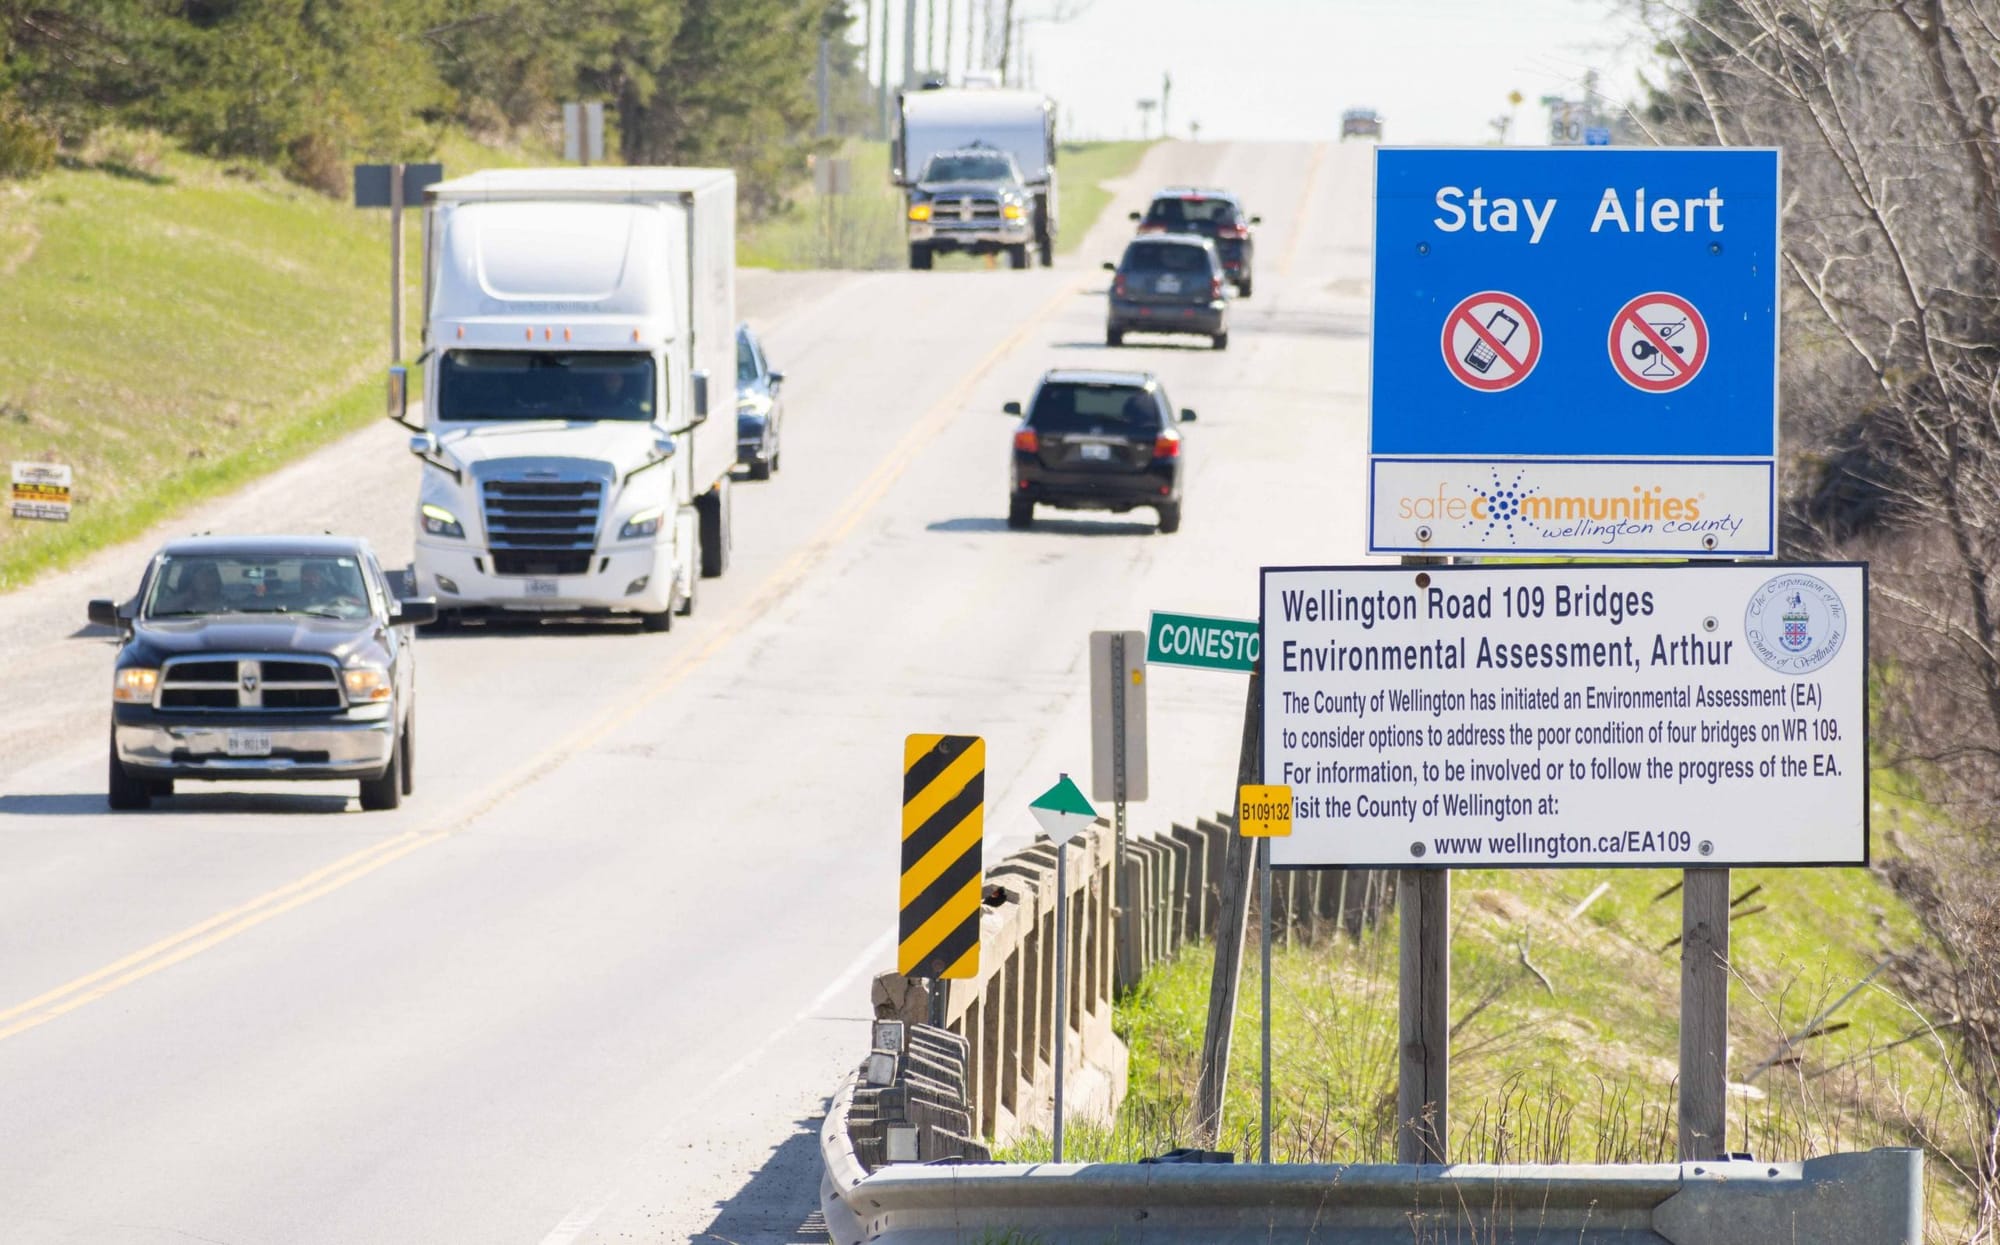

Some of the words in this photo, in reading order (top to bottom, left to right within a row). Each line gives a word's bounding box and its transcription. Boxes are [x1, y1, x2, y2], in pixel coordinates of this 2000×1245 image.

[1433, 186, 1558, 244] Stay
[1590, 186, 1725, 232] Alert
[1542, 519, 1654, 544] wellington
[1662, 514, 1744, 537] county
[1282, 589, 1416, 629] Wellington
[1428, 587, 1491, 619] Road
[1503, 586, 1544, 618] 109
[1556, 585, 1653, 625] Bridges
[1283, 637, 1464, 672] Environmental
[1476, 637, 1639, 672] Assessment,
[1651, 634, 1732, 665] Arthur
[1283, 692, 1309, 713] The
[1314, 691, 1366, 718] County
[1371, 690, 1384, 712] of
[1389, 689, 1464, 717] Wellington
[1471, 688, 1496, 710] has
[1502, 687, 1558, 710] initiated
[1564, 692, 1581, 709] an
[1587, 685, 1690, 708] Environmental
[1696, 685, 1786, 707] Assessment
[1791, 684, 1821, 711] (EA)
[1283, 728, 1296, 748] to
[1302, 726, 1365, 748] consider
[1369, 725, 1423, 753] options
[1428, 725, 1442, 746] to
[1448, 724, 1505, 746] address
[1510, 723, 1532, 745] the
[1538, 728, 1571, 750] poor
[1575, 721, 1643, 744] condition
[1649, 721, 1662, 743] of
[1667, 721, 1696, 743] four
[1702, 720, 1756, 748] bridges
[1762, 725, 1779, 741] on
[1782, 719, 1806, 741] WR
[1813, 719, 1841, 741] 109.
[1284, 762, 1311, 784] For
[1317, 760, 1417, 785] information,
[1423, 761, 1439, 781] to
[1446, 760, 1464, 781] be
[1471, 758, 1541, 780] involved
[1547, 763, 1563, 780] or
[1569, 759, 1585, 779] to
[1591, 757, 1641, 779] follow
[1647, 757, 1673, 778] the
[1679, 761, 1753, 784] progress
[1760, 755, 1775, 777] of
[1781, 755, 1807, 777] the
[1814, 754, 1841, 776] EA.
[1242, 803, 1290, 821] B109132
[1291, 796, 1320, 818] isit
[1325, 796, 1351, 817] the
[1357, 795, 1416, 822] County
[1423, 794, 1438, 816] of
[1443, 794, 1532, 821] Wellington
[1539, 794, 1558, 815] at:
